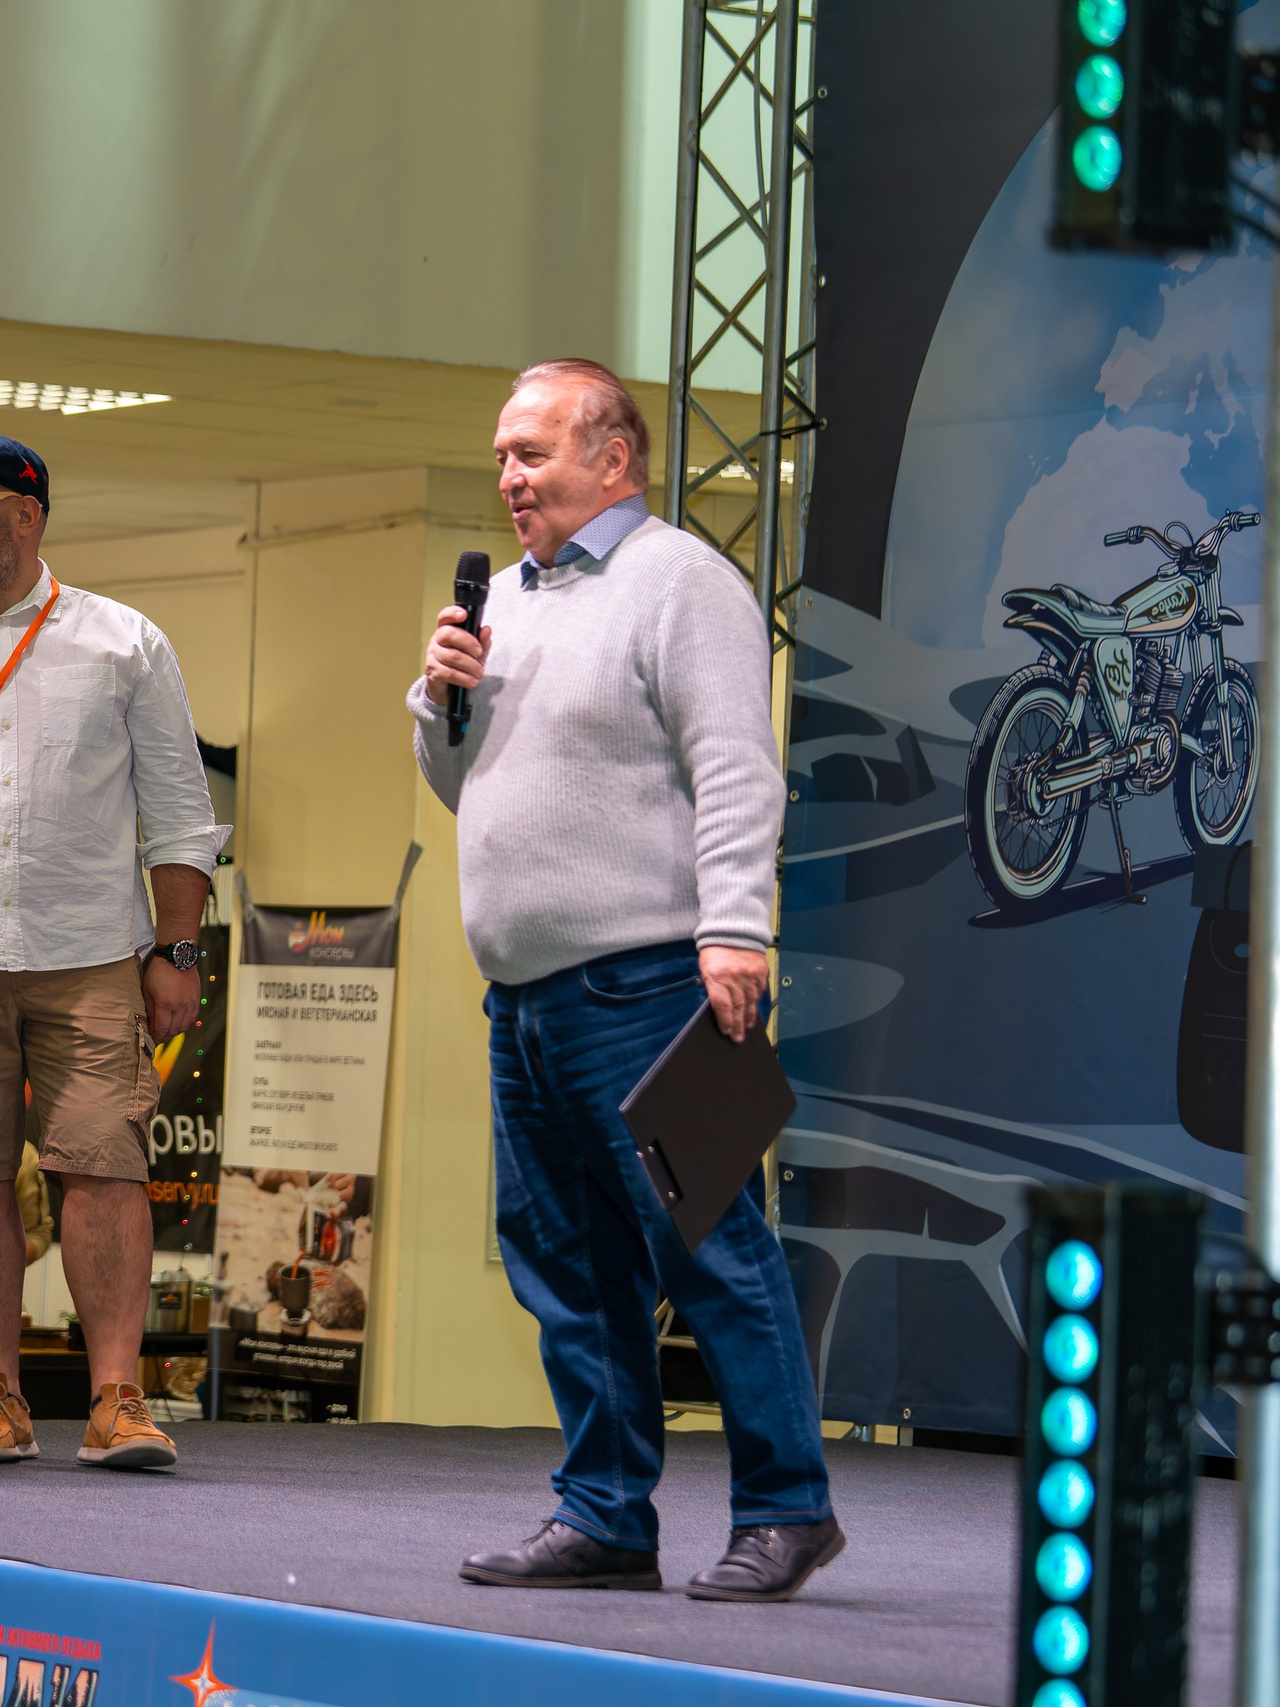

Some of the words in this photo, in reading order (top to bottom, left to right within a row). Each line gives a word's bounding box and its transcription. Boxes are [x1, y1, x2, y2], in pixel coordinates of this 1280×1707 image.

[257, 981, 307, 1000] ГОТОВАЯ
[310, 983, 335, 1003] ЕДА
[339, 984, 379, 1004] ЗДЕСЬ
[6, 1626, 60, 1653] АКТИВНОГО
[61, 1636, 102, 1661] ОТДЫХА
